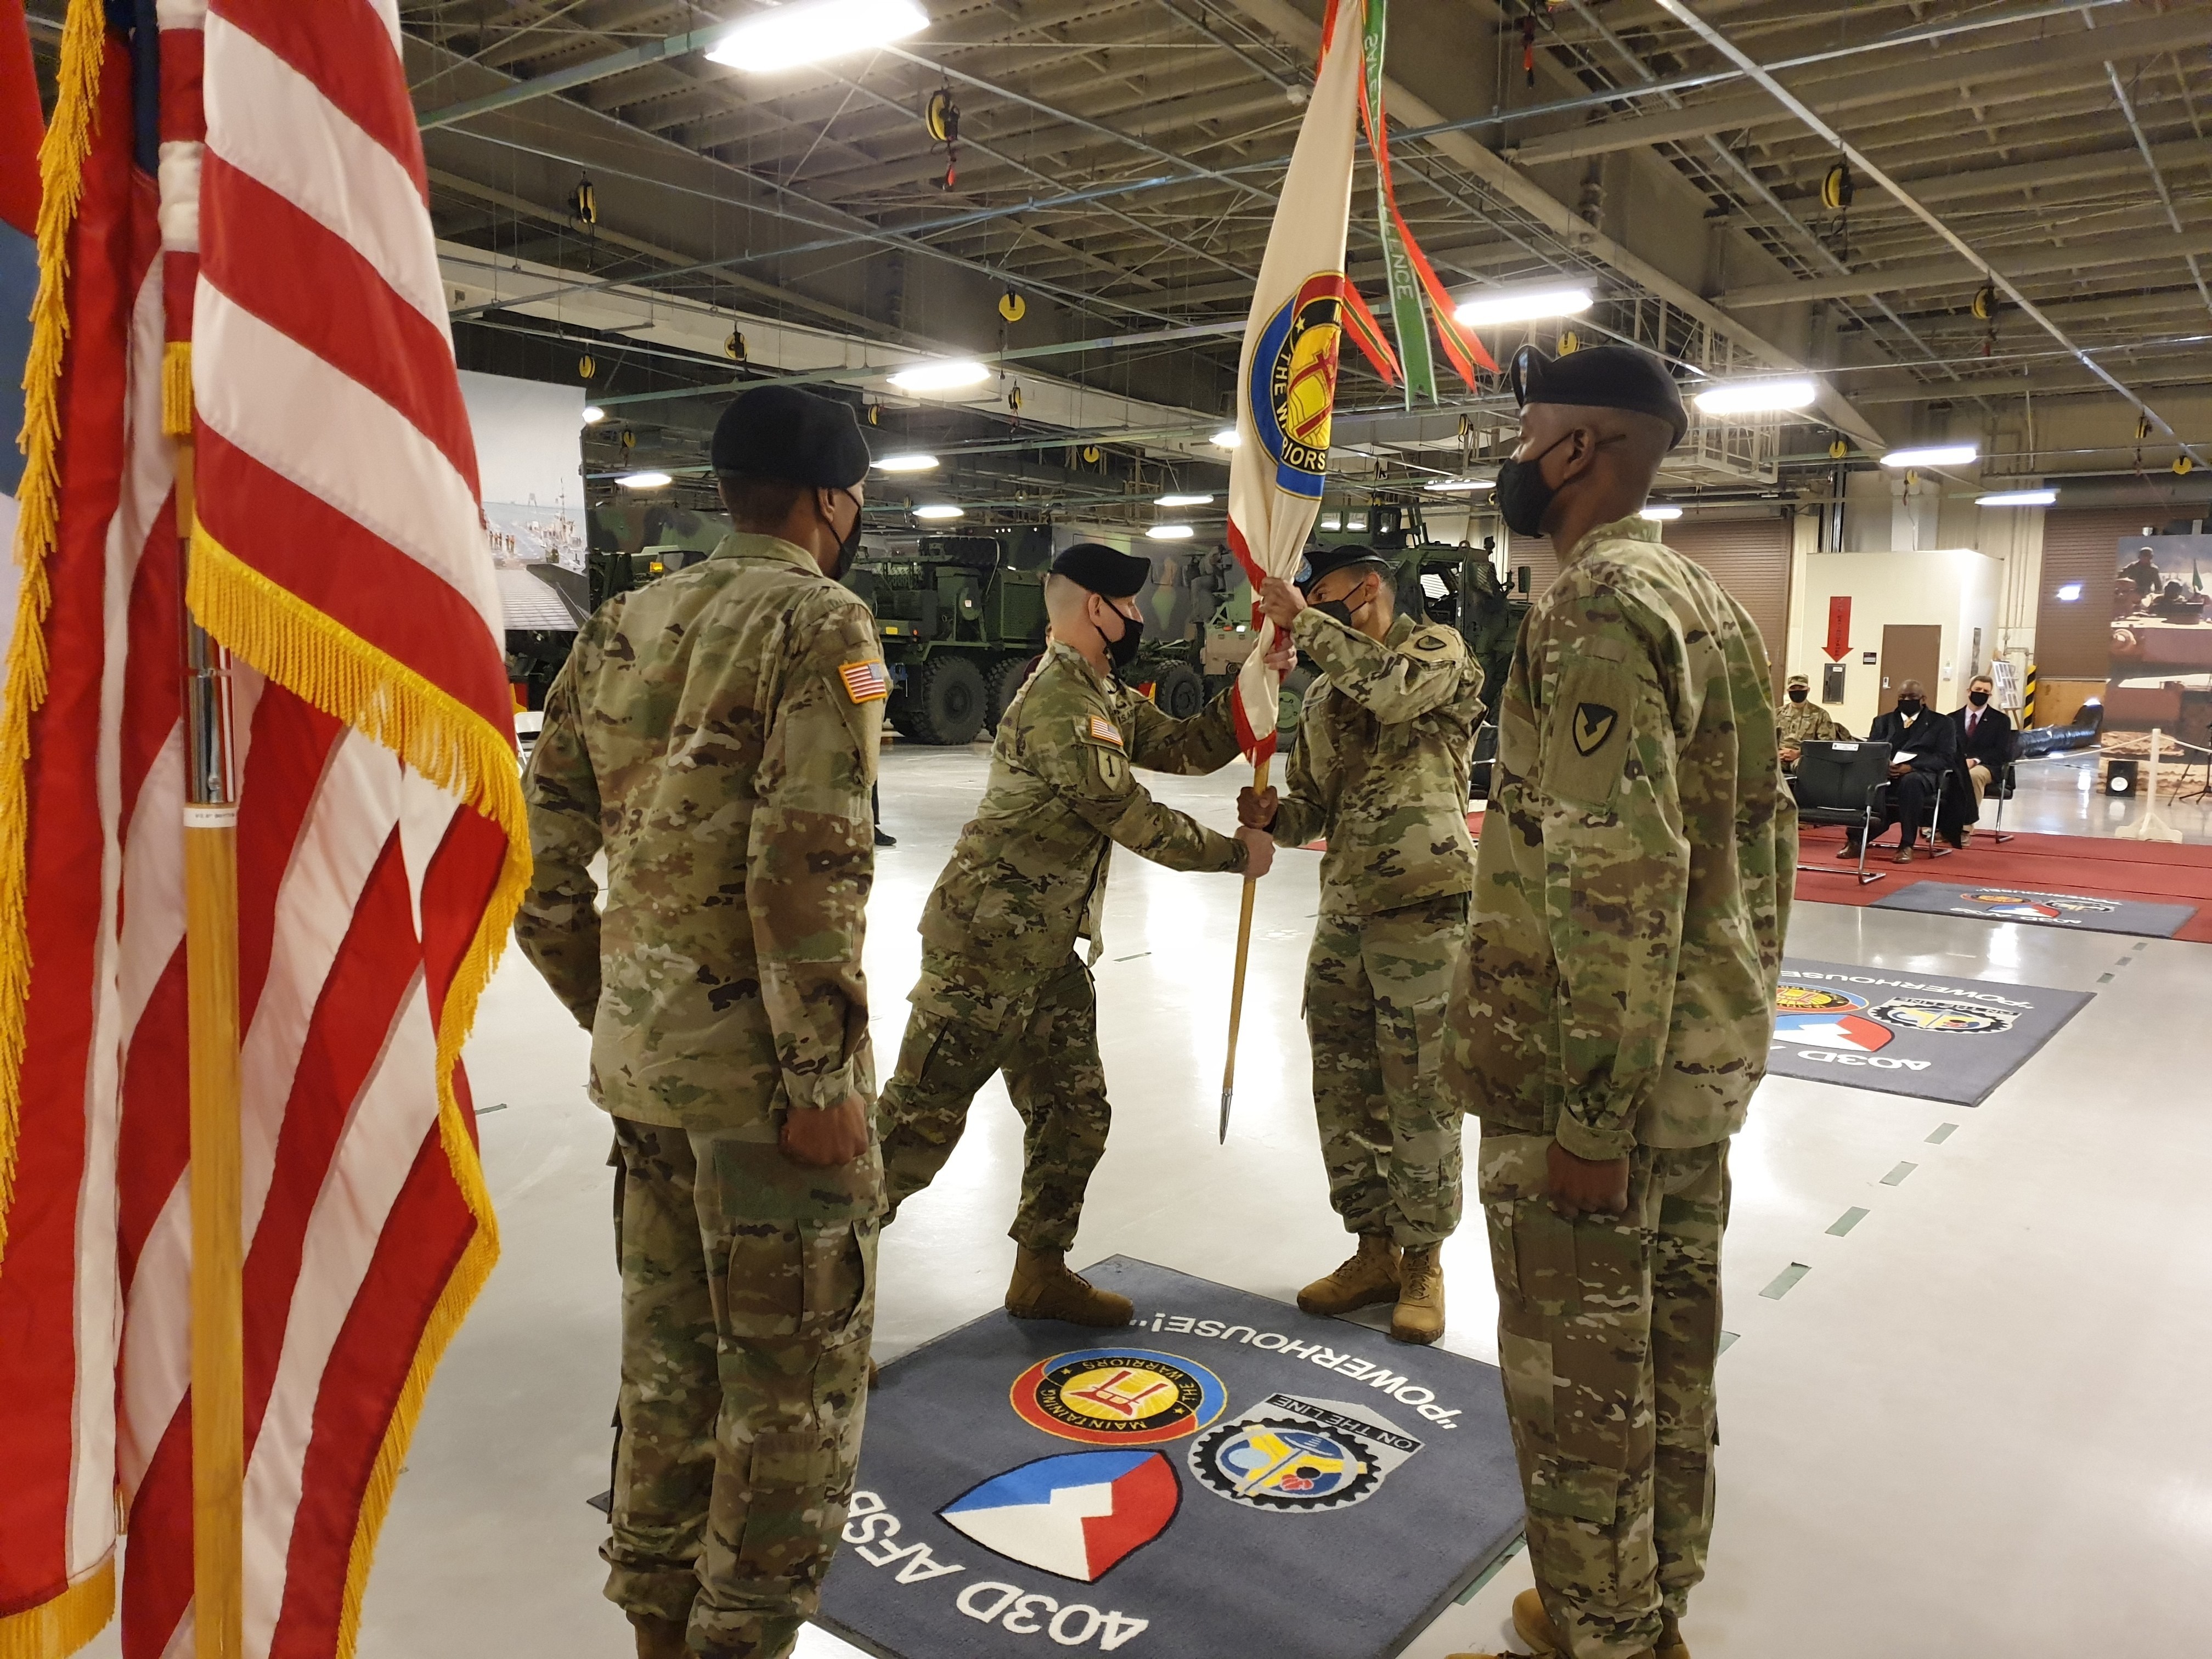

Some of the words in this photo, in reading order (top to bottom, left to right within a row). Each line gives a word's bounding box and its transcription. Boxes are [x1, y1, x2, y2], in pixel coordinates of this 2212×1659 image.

[1274, 353, 1290, 396] THE
[1797, 1050, 1932, 1070] 403D
[1082, 1358, 1183, 1380] WARRIORS
[1179, 1382, 1198, 1402] THE
[1040, 1389, 1148, 1430] MAINTAINING
[1276, 1396, 1325, 1420] LINE
[1325, 1414, 1371, 1443] THE
[1380, 1430, 1414, 1451] ON
[956, 1581, 1149, 1651] 403D
